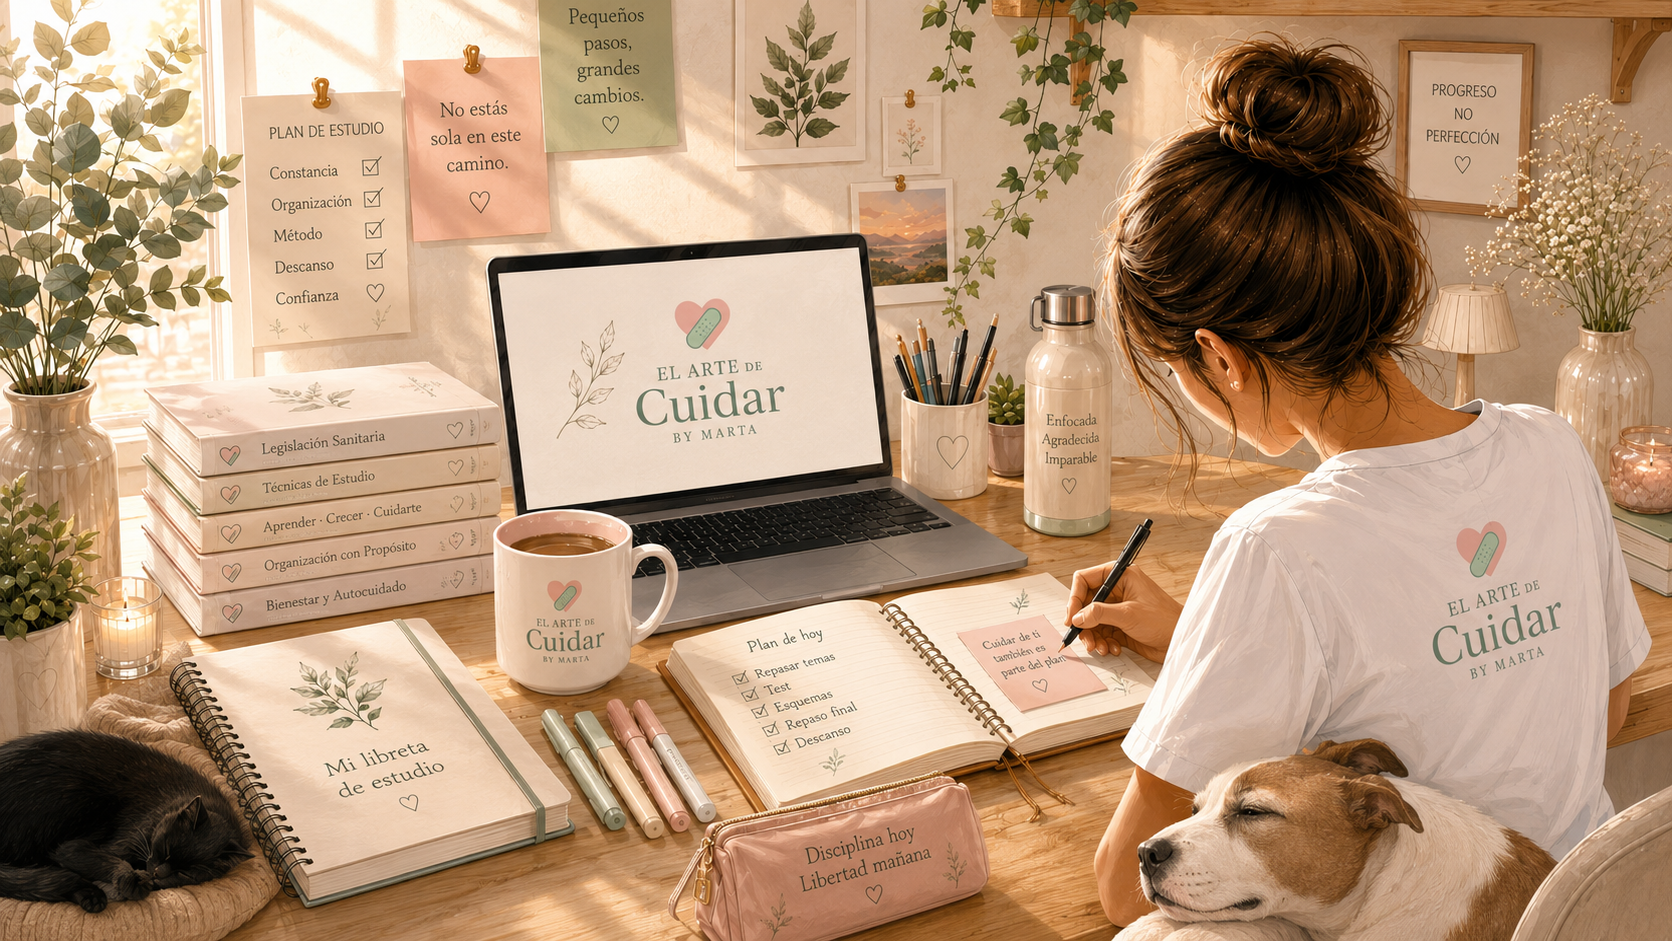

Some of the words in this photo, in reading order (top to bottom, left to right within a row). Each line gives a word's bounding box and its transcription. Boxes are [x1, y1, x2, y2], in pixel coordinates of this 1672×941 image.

[568, 7, 645, 29] Pequeños
[583, 37, 632, 56] pasos,
[576, 58, 640, 83] grandes
[574, 86, 645, 105] cambios.
[1432, 83, 1497, 98] PROGRESO
[439, 101, 465, 118] No
[469, 99, 508, 117] estás
[1454, 107, 1473, 121] NO
[269, 125, 304, 140] PLAN
[308, 124, 325, 138] DE
[329, 121, 385, 137] ESTUDIO
[430, 128, 461, 146] sola
[466, 131, 486, 144] en
[490, 128, 522, 143] este
[1426, 128, 1500, 145] PERFECCIÓN
[269, 164, 339, 180] Constancia
[446, 155, 509, 173] camino.
[271, 194, 352, 215] Organización
[273, 226, 323, 243] Método
[274, 260, 335, 275] Descanso
[275, 289, 340, 306] Confianza
[656, 366, 681, 382] EL
[687, 359, 739, 378] ARTE
[744, 361, 763, 372] DE
[635, 380, 785, 426] Cuidar
[1046, 413, 1098, 427] Enfocada
[261, 436, 329, 456] Legislación
[332, 430, 386, 448] Sanitaria
[672, 431, 693, 443] BY
[701, 424, 757, 441] MARTA
[1041, 431, 1100, 449] Agradecida
[1045, 451, 1098, 469] Imparable
[262, 477, 312, 494] Técnicas
[315, 474, 329, 487] de
[332, 470, 376, 486] Estudio
[263, 515, 317, 535] Aprender
[326, 511, 363, 524] Crecer
[373, 503, 422, 518] Cuidarte
[264, 551, 338, 572] Organización
[340, 550, 360, 561] con
[363, 541, 417, 559] Propósito
[265, 594, 320, 612] Bienestar
[322, 595, 330, 606] y
[333, 579, 407, 602] Autocuidado
[1447, 598, 1471, 618] EL
[1475, 582, 1521, 609] ARTE
[1524, 579, 1540, 594] DE
[536, 618, 549, 627] EL
[552, 618, 581, 628] ARTE
[584, 618, 595, 626] DE
[1432, 601, 1562, 666] Cuidar
[526, 628, 605, 652] Cuidar
[746, 638, 779, 653] Plan
[782, 632, 797, 645] de
[799, 628, 823, 643] hoy
[982, 636, 1016, 650] Cuidar
[1018, 632, 1031, 642] de
[542, 655, 554, 663] BY
[558, 655, 590, 664] MARTA
[993, 647, 1034, 663] también
[1035, 644, 1046, 653] es
[1469, 664, 1487, 680] BY
[1494, 646, 1545, 673] MARTA
[754, 661, 800, 679] Repasar
[802, 653, 836, 667] temas
[1000, 664, 1027, 680] parte
[1028, 659, 1044, 671] del
[1044, 654, 1067, 669] plan
[763, 681, 792, 696] Test
[773, 690, 834, 713] Esquemas
[784, 712, 828, 730] Repaso
[830, 701, 858, 718] final
[794, 726, 851, 749] Descanso
[323, 757, 357, 778] Mi
[359, 742, 430, 767] libreta
[338, 781, 365, 798] de
[371, 761, 445, 789] estudio
[805, 834, 885, 865] Disciplina
[886, 827, 915, 844] hoy
[799, 859, 869, 893] Libertad
[872, 848, 932, 873] mañana
